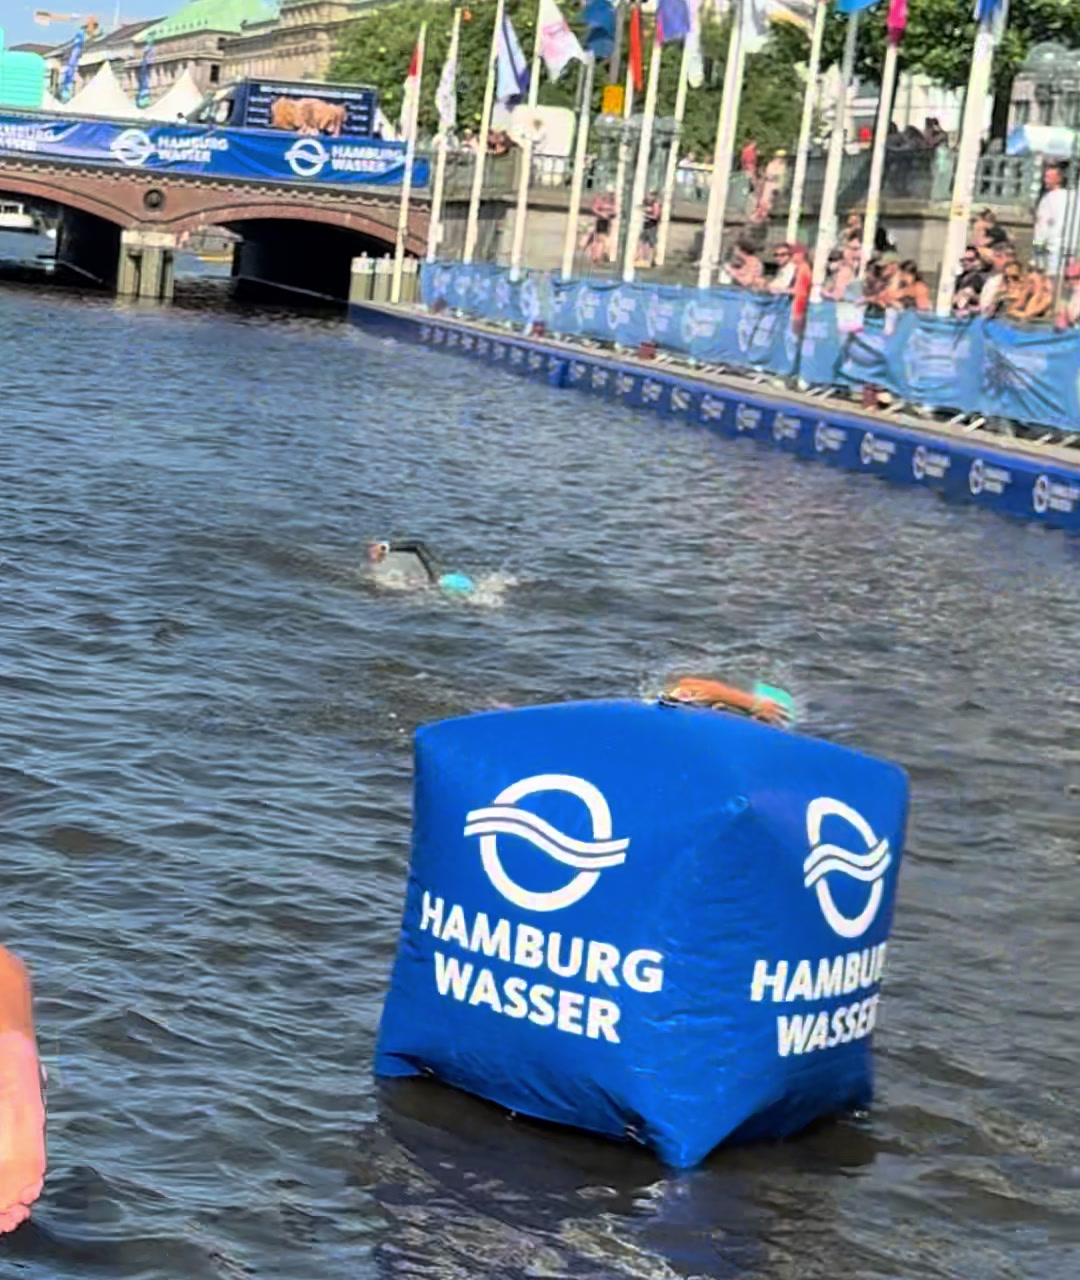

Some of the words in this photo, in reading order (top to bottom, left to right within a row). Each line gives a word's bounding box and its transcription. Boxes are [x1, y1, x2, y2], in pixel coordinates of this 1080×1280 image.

[157, 136, 229, 151] HAMBURG
[419, 890, 665, 993] HAMBURG
[434, 951, 621, 1044] WASSER
